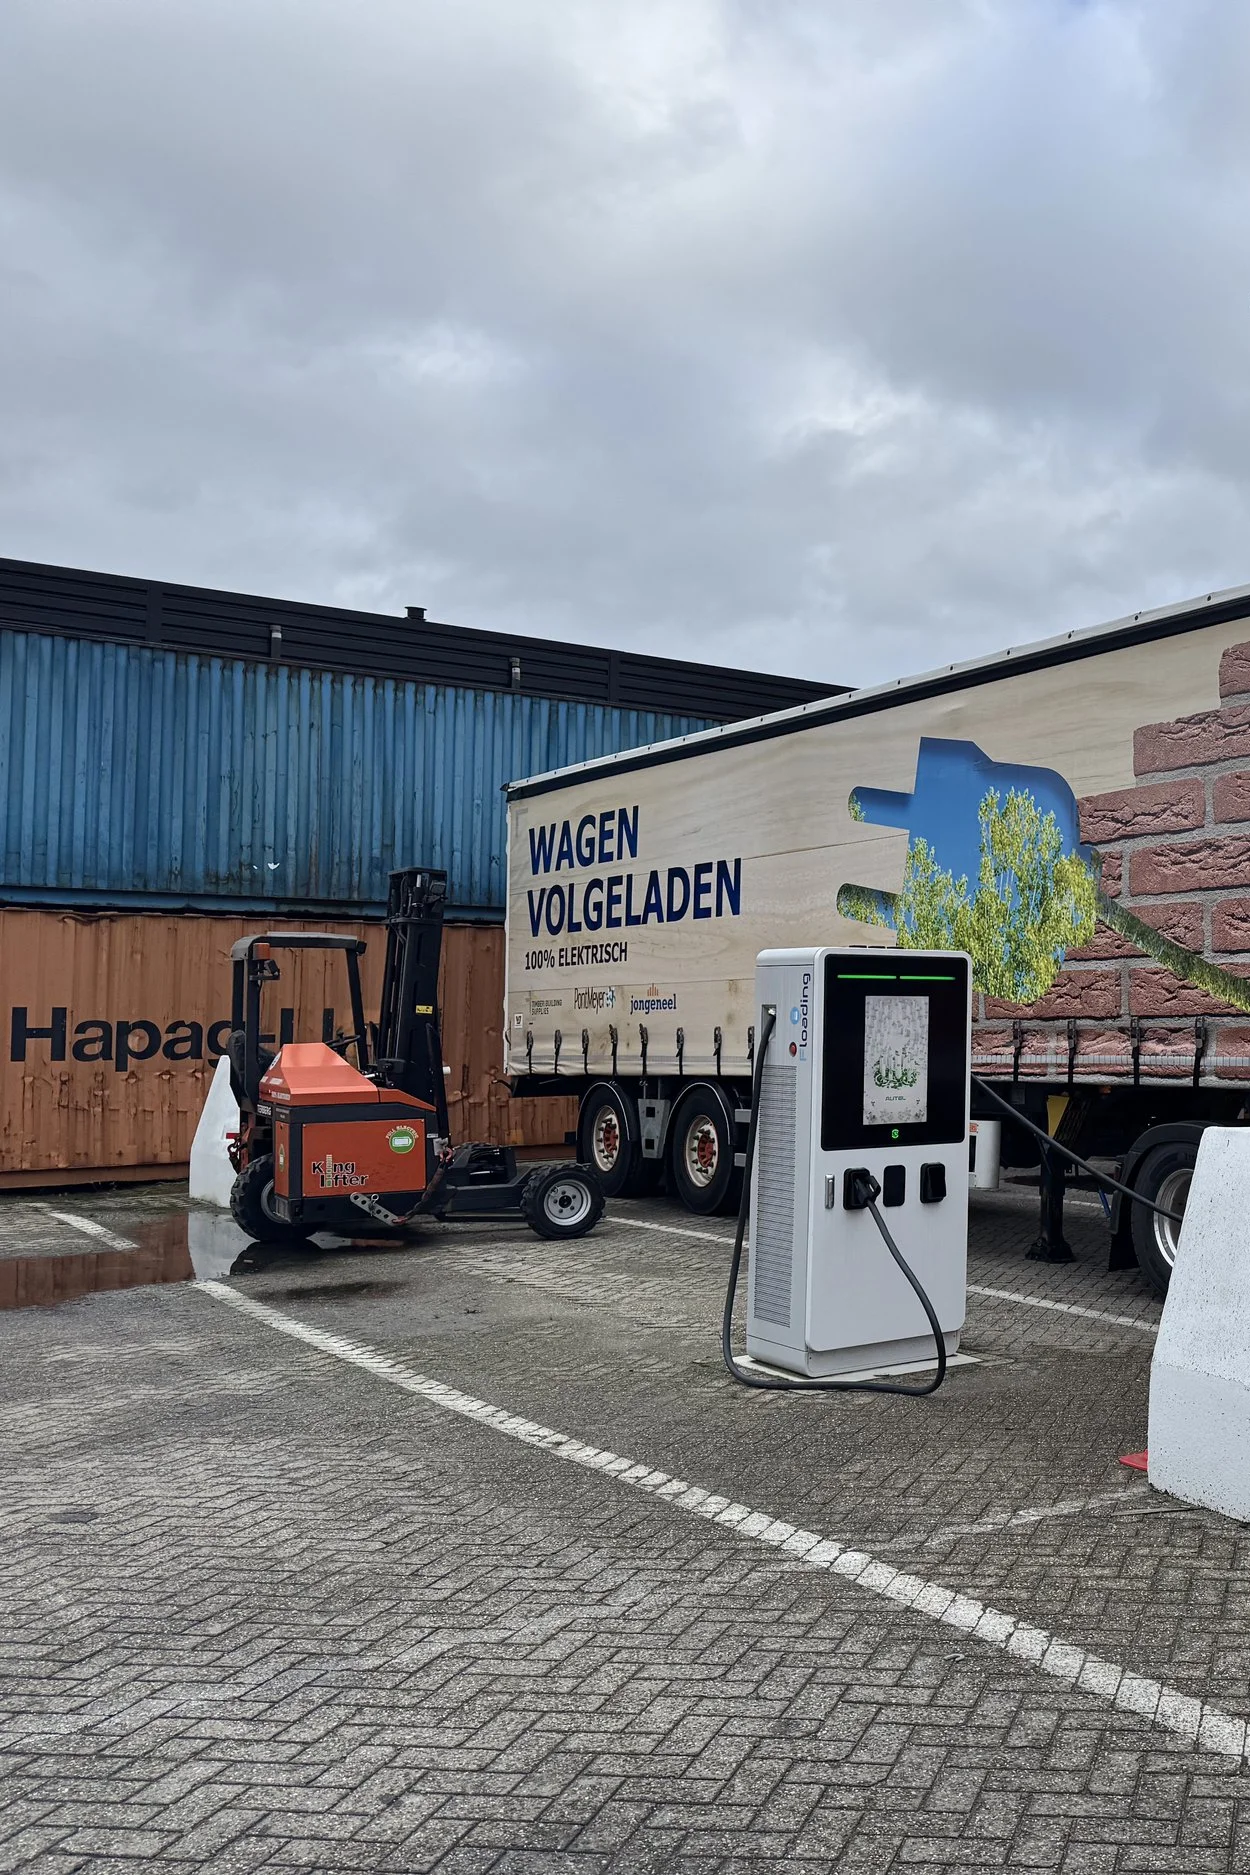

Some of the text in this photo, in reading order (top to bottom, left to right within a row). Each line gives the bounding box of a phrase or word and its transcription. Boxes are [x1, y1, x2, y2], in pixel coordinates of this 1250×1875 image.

[528, 805, 639, 876] WAGEN
[527, 858, 742, 937] VOLGELADEN
[525, 941, 628, 970] 100% ELEKTRISCH
[574, 987, 606, 1014] PontMeyer
[630, 993, 677, 1014] jongeneel
[312, 1154, 355, 1174] King
